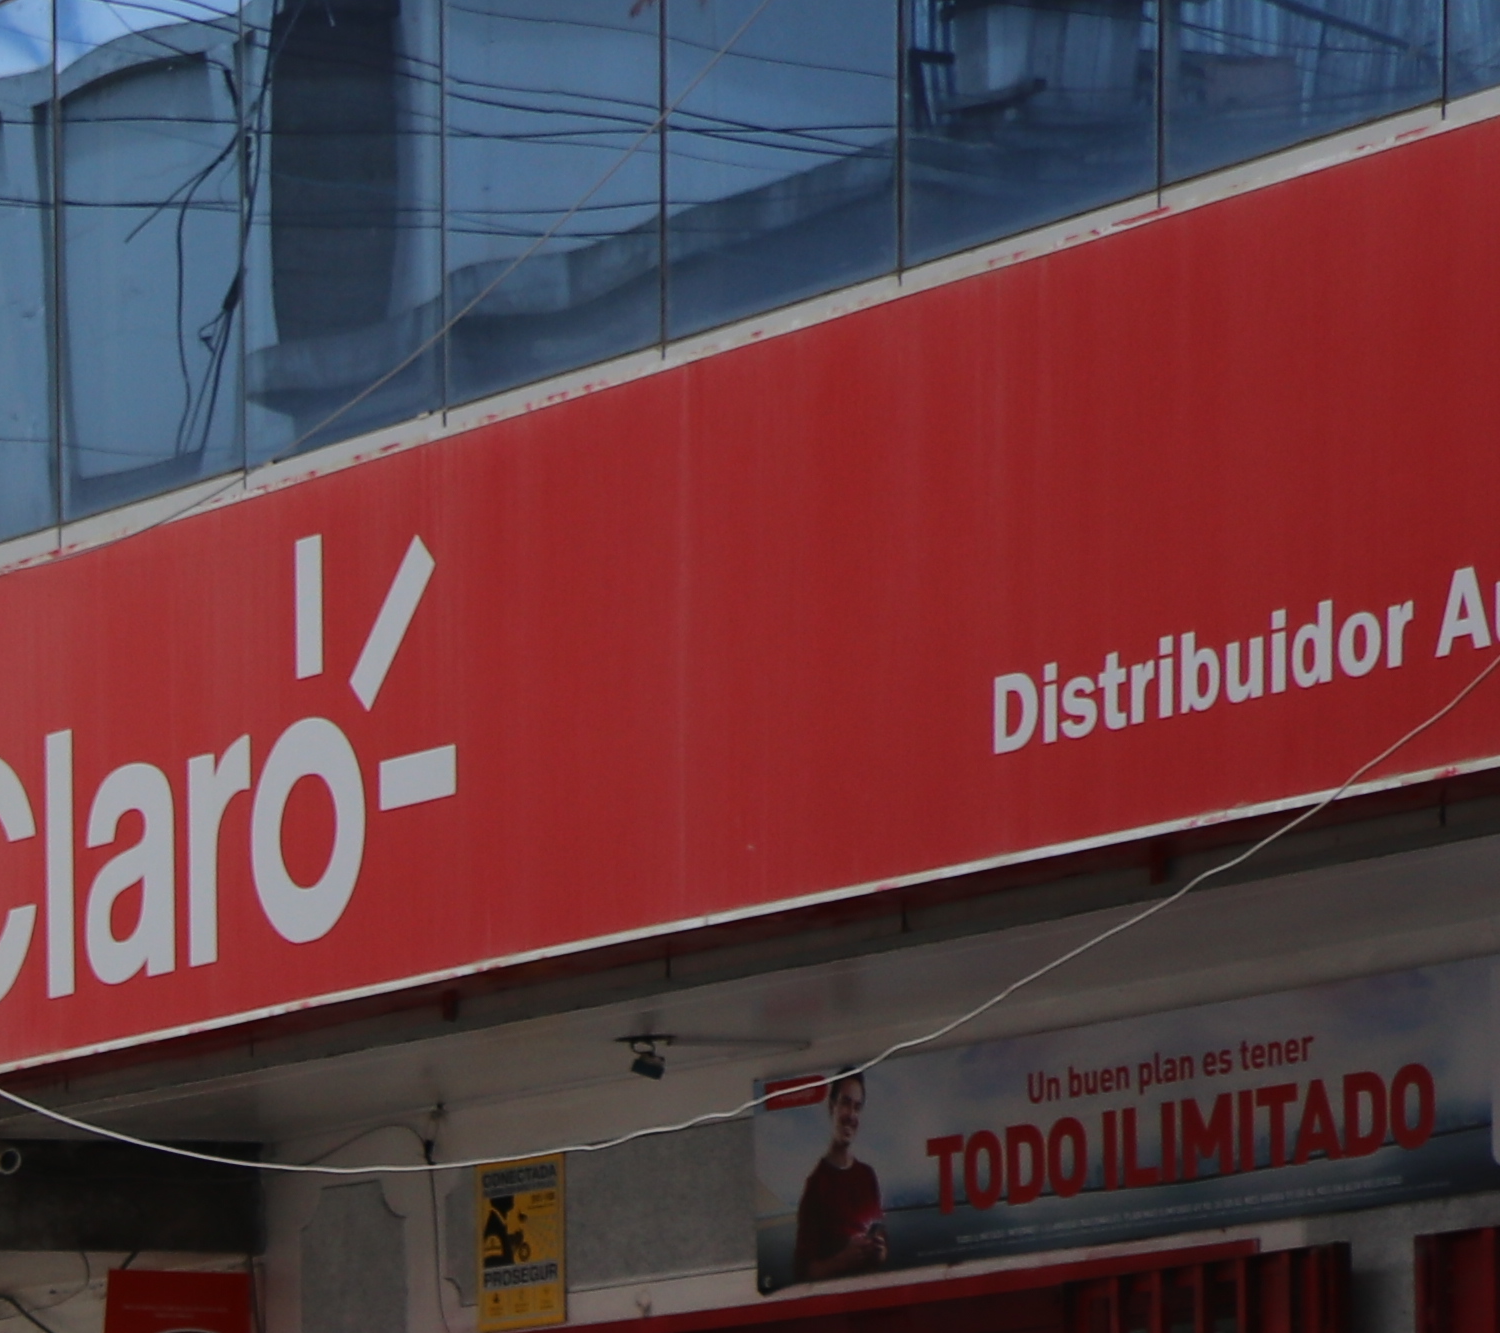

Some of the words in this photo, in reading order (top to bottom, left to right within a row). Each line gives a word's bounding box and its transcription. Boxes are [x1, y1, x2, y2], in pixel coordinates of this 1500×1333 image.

[993, 590, 1414, 757] Distribuidor
[1436, 564, 1500, 657] A
[1026, 1070, 1062, 1106] Un
[1067, 1063, 1131, 1099] buen
[1137, 1051, 1196, 1096] plan
[1201, 1046, 1234, 1075] es
[1238, 1035, 1315, 1071] tener
[925, 1114, 1090, 1217] TODO
[1101, 1062, 1437, 1194] ILIMITADO
[483, 1262, 558, 1289] PROSEGUR
